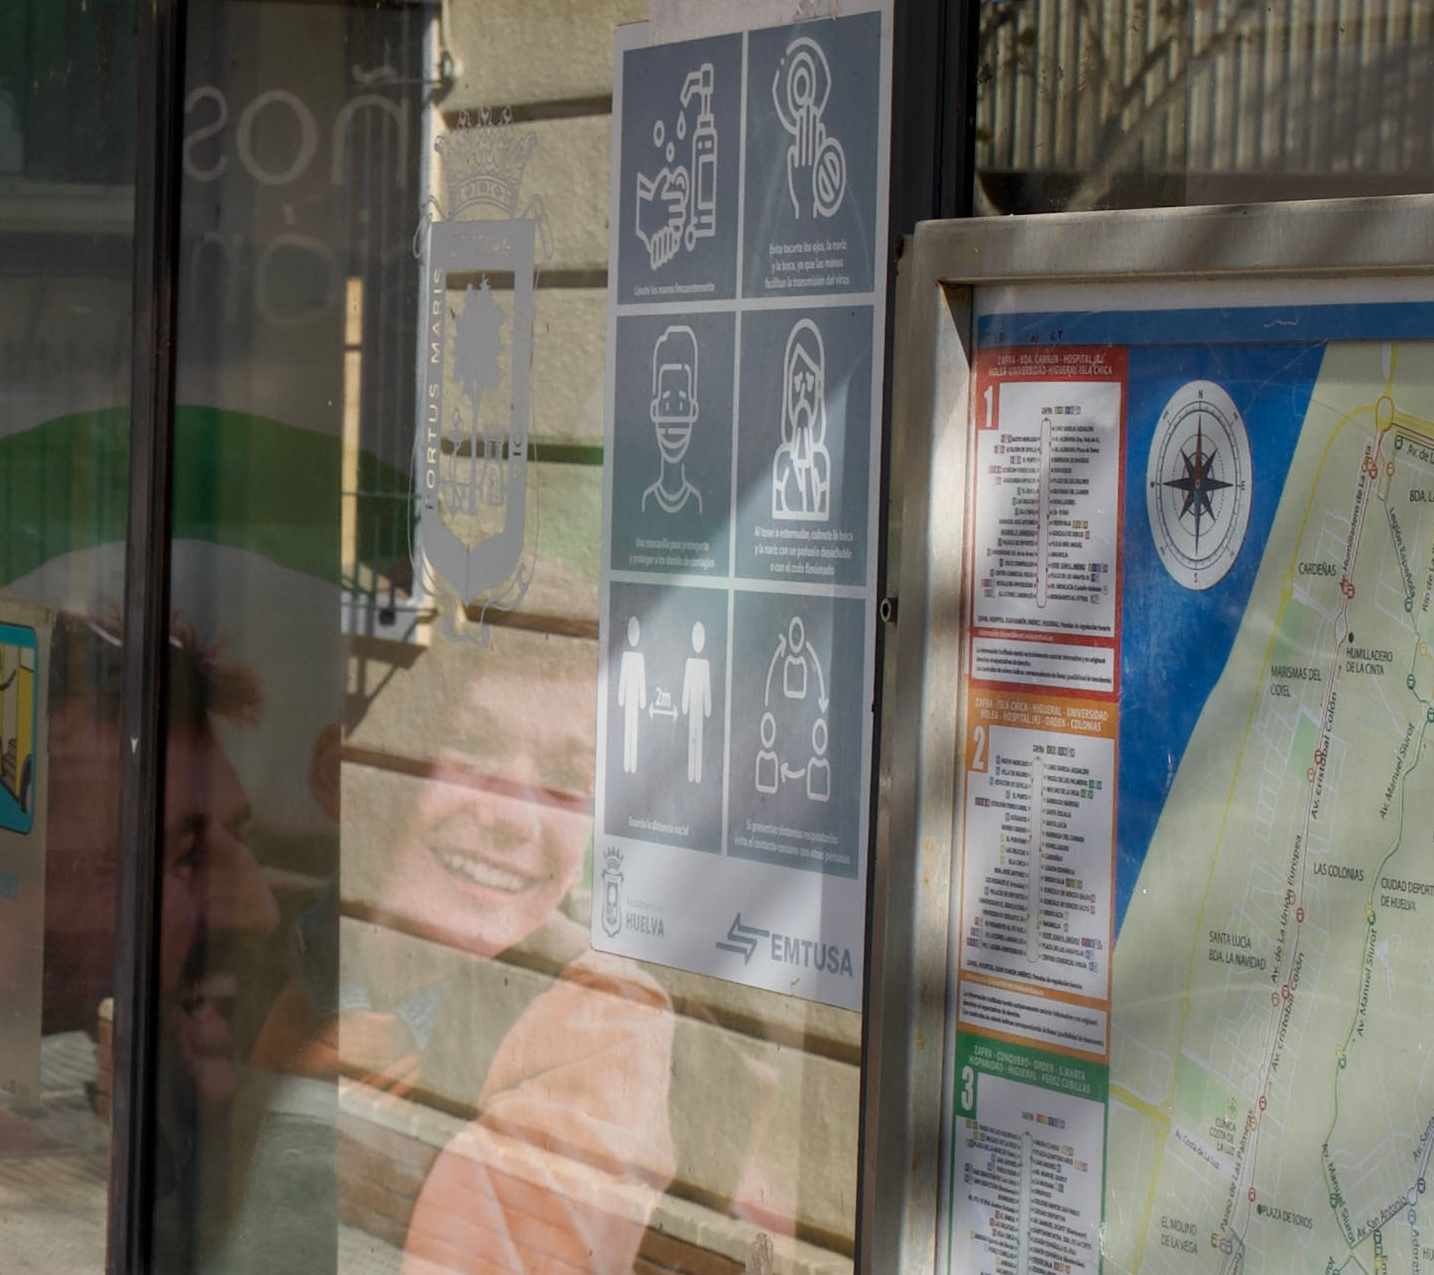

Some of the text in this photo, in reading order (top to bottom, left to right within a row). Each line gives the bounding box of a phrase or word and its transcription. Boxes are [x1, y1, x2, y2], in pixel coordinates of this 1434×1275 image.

[984, 386, 994, 427] 1
[655, 686, 671, 707] 2m
[972, 726, 985, 770] 2
[626, 912, 665, 938] HUELVA
[770, 933, 854, 977] EMTUSA
[961, 1066, 975, 1111] 3
